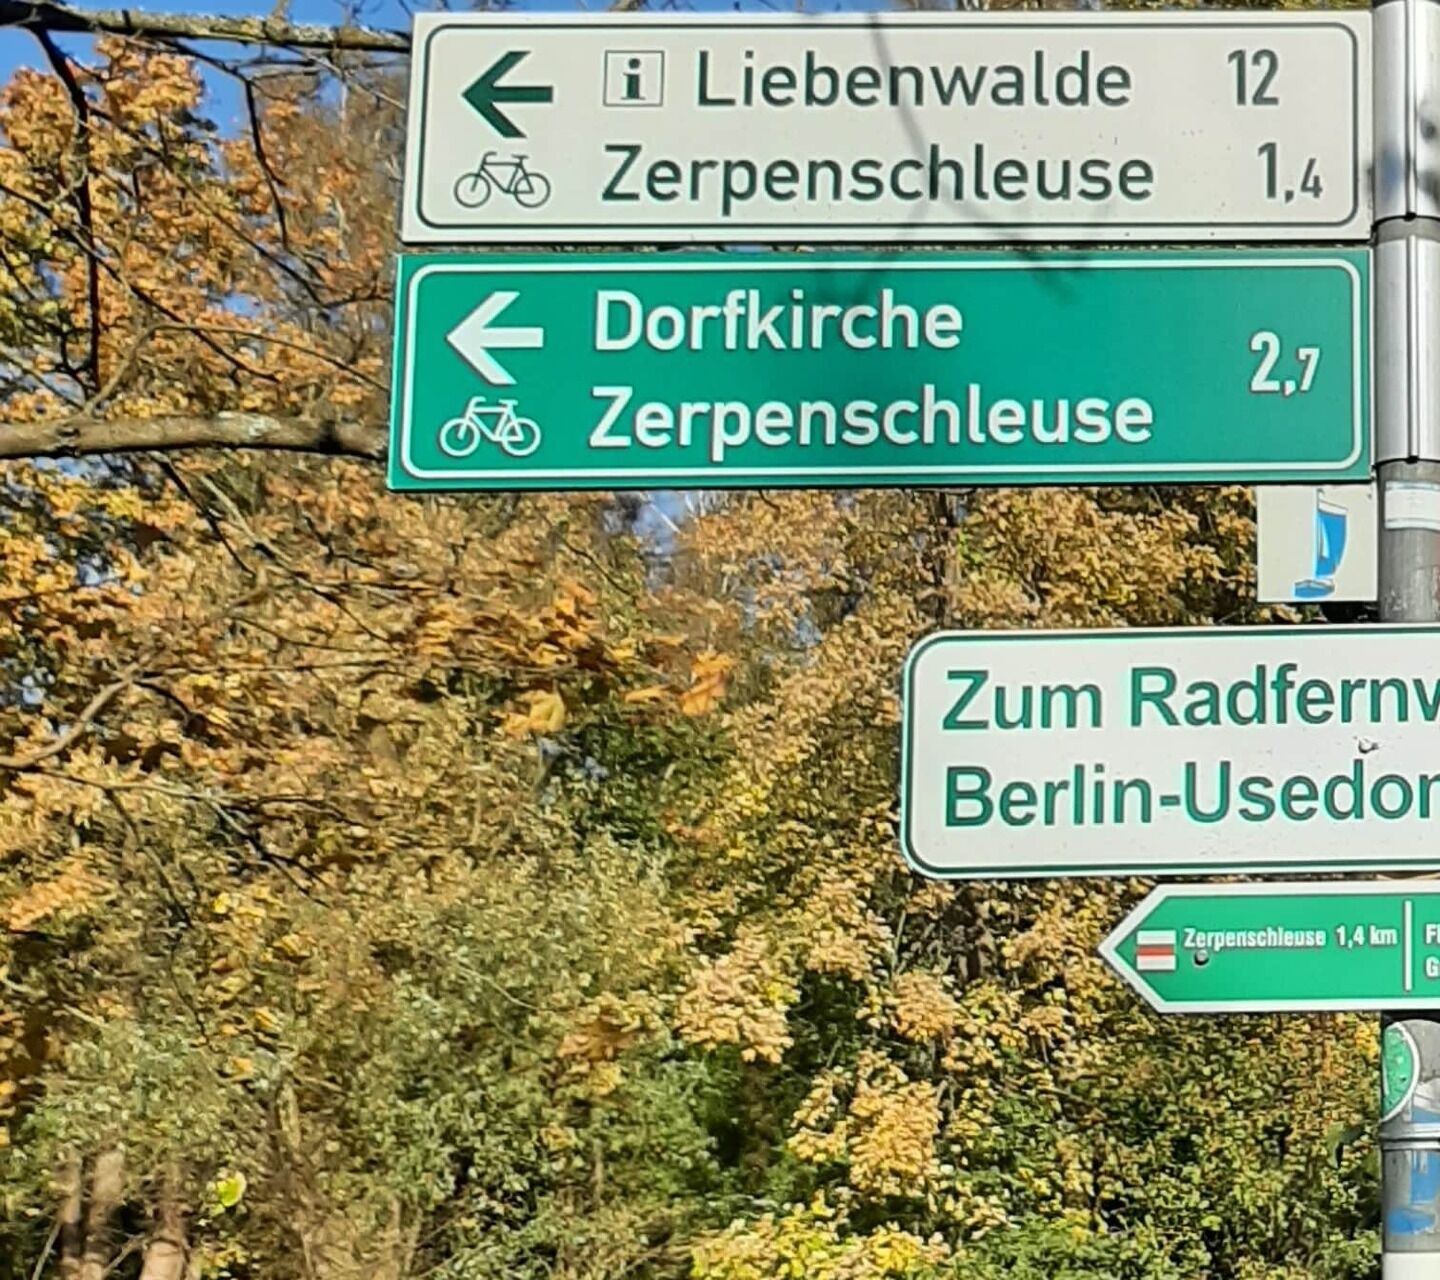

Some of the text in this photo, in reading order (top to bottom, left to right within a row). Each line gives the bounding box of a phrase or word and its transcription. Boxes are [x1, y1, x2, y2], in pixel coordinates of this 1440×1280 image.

[698, 49, 1280, 106] Liebenwalde 12
[602, 142, 1323, 215] Zerpenschleuse 1,4
[594, 289, 963, 351] Dorfkirche
[1249, 330, 1320, 397] 2,7
[588, 384, 1154, 462] Zerpenschleuse
[942, 669, 1103, 730] Zum
[1184, 925, 1397, 950] Zerpenschleuse 1,4 km
